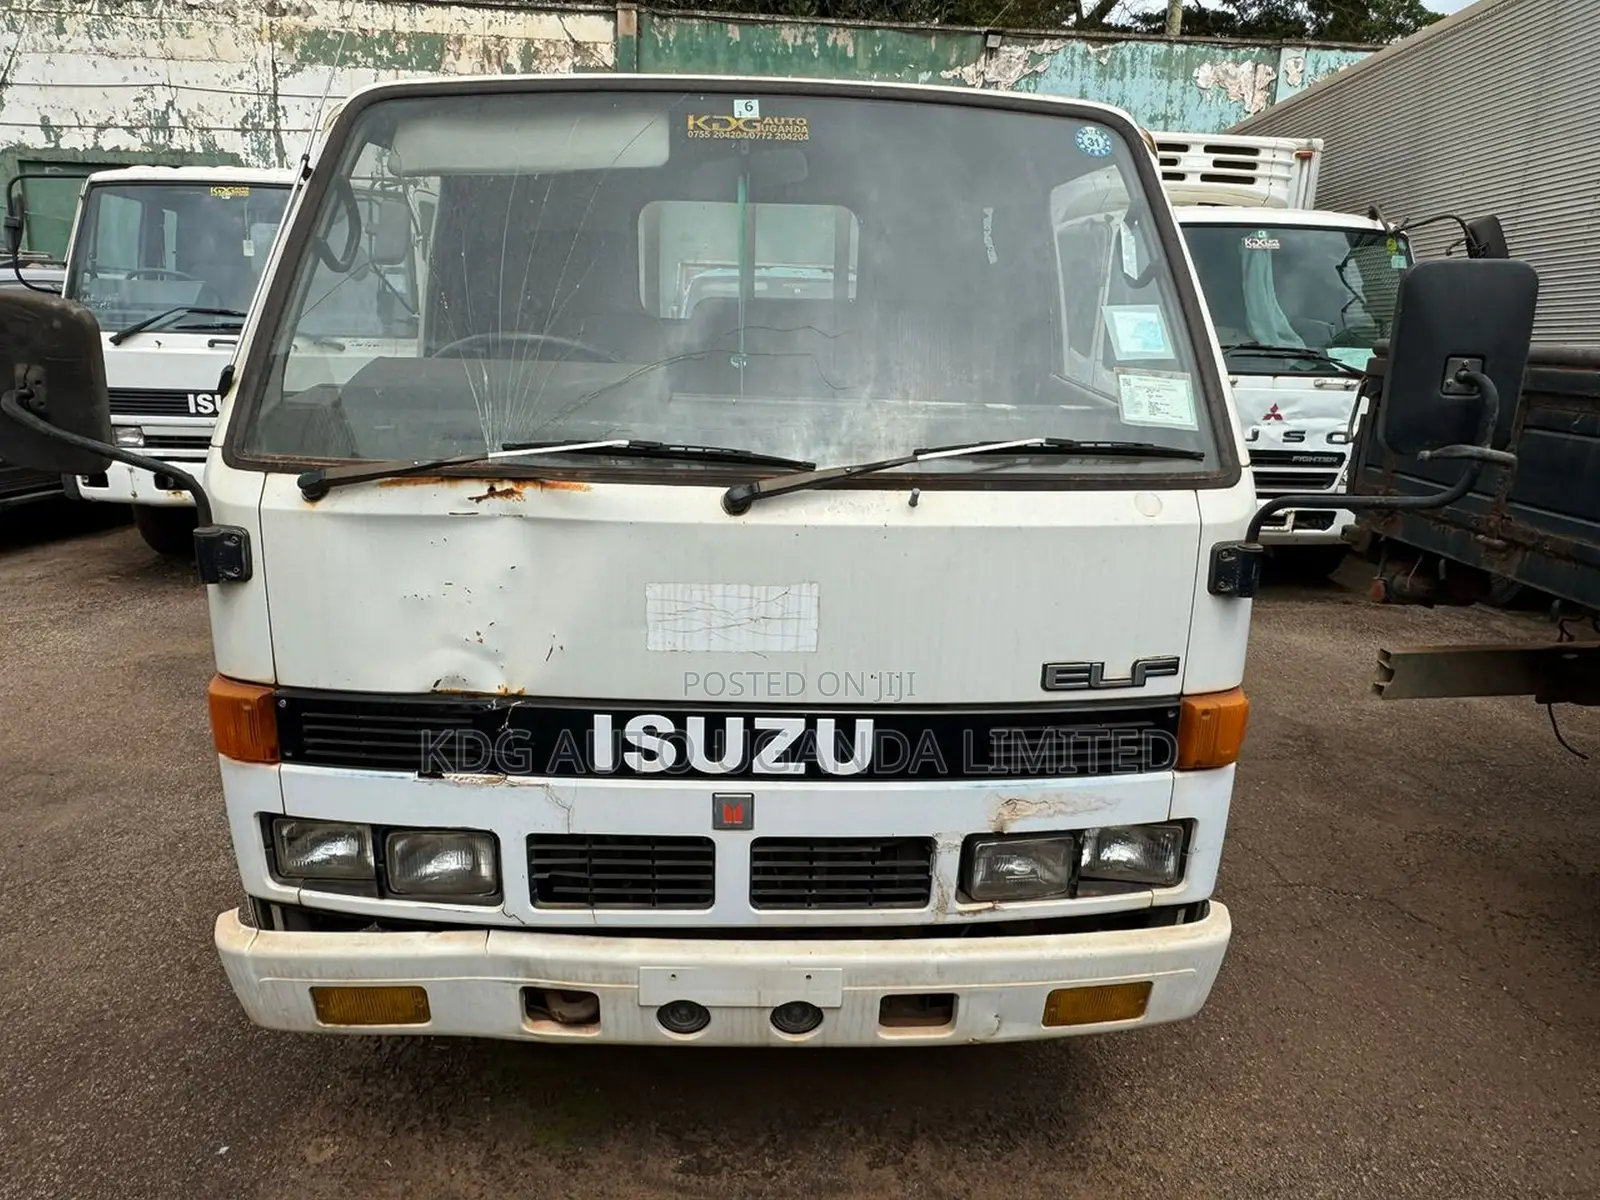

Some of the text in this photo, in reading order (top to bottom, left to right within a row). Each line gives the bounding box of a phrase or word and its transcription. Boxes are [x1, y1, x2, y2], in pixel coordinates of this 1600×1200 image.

[762, 116, 807, 125] AUTO
[761, 124, 808, 133] UGANDA
[687, 130, 711, 139] 0755
[775, 132, 809, 141] 204204
[1041, 656, 1180, 691] ELF
[593, 713, 875, 776] ISUZU
